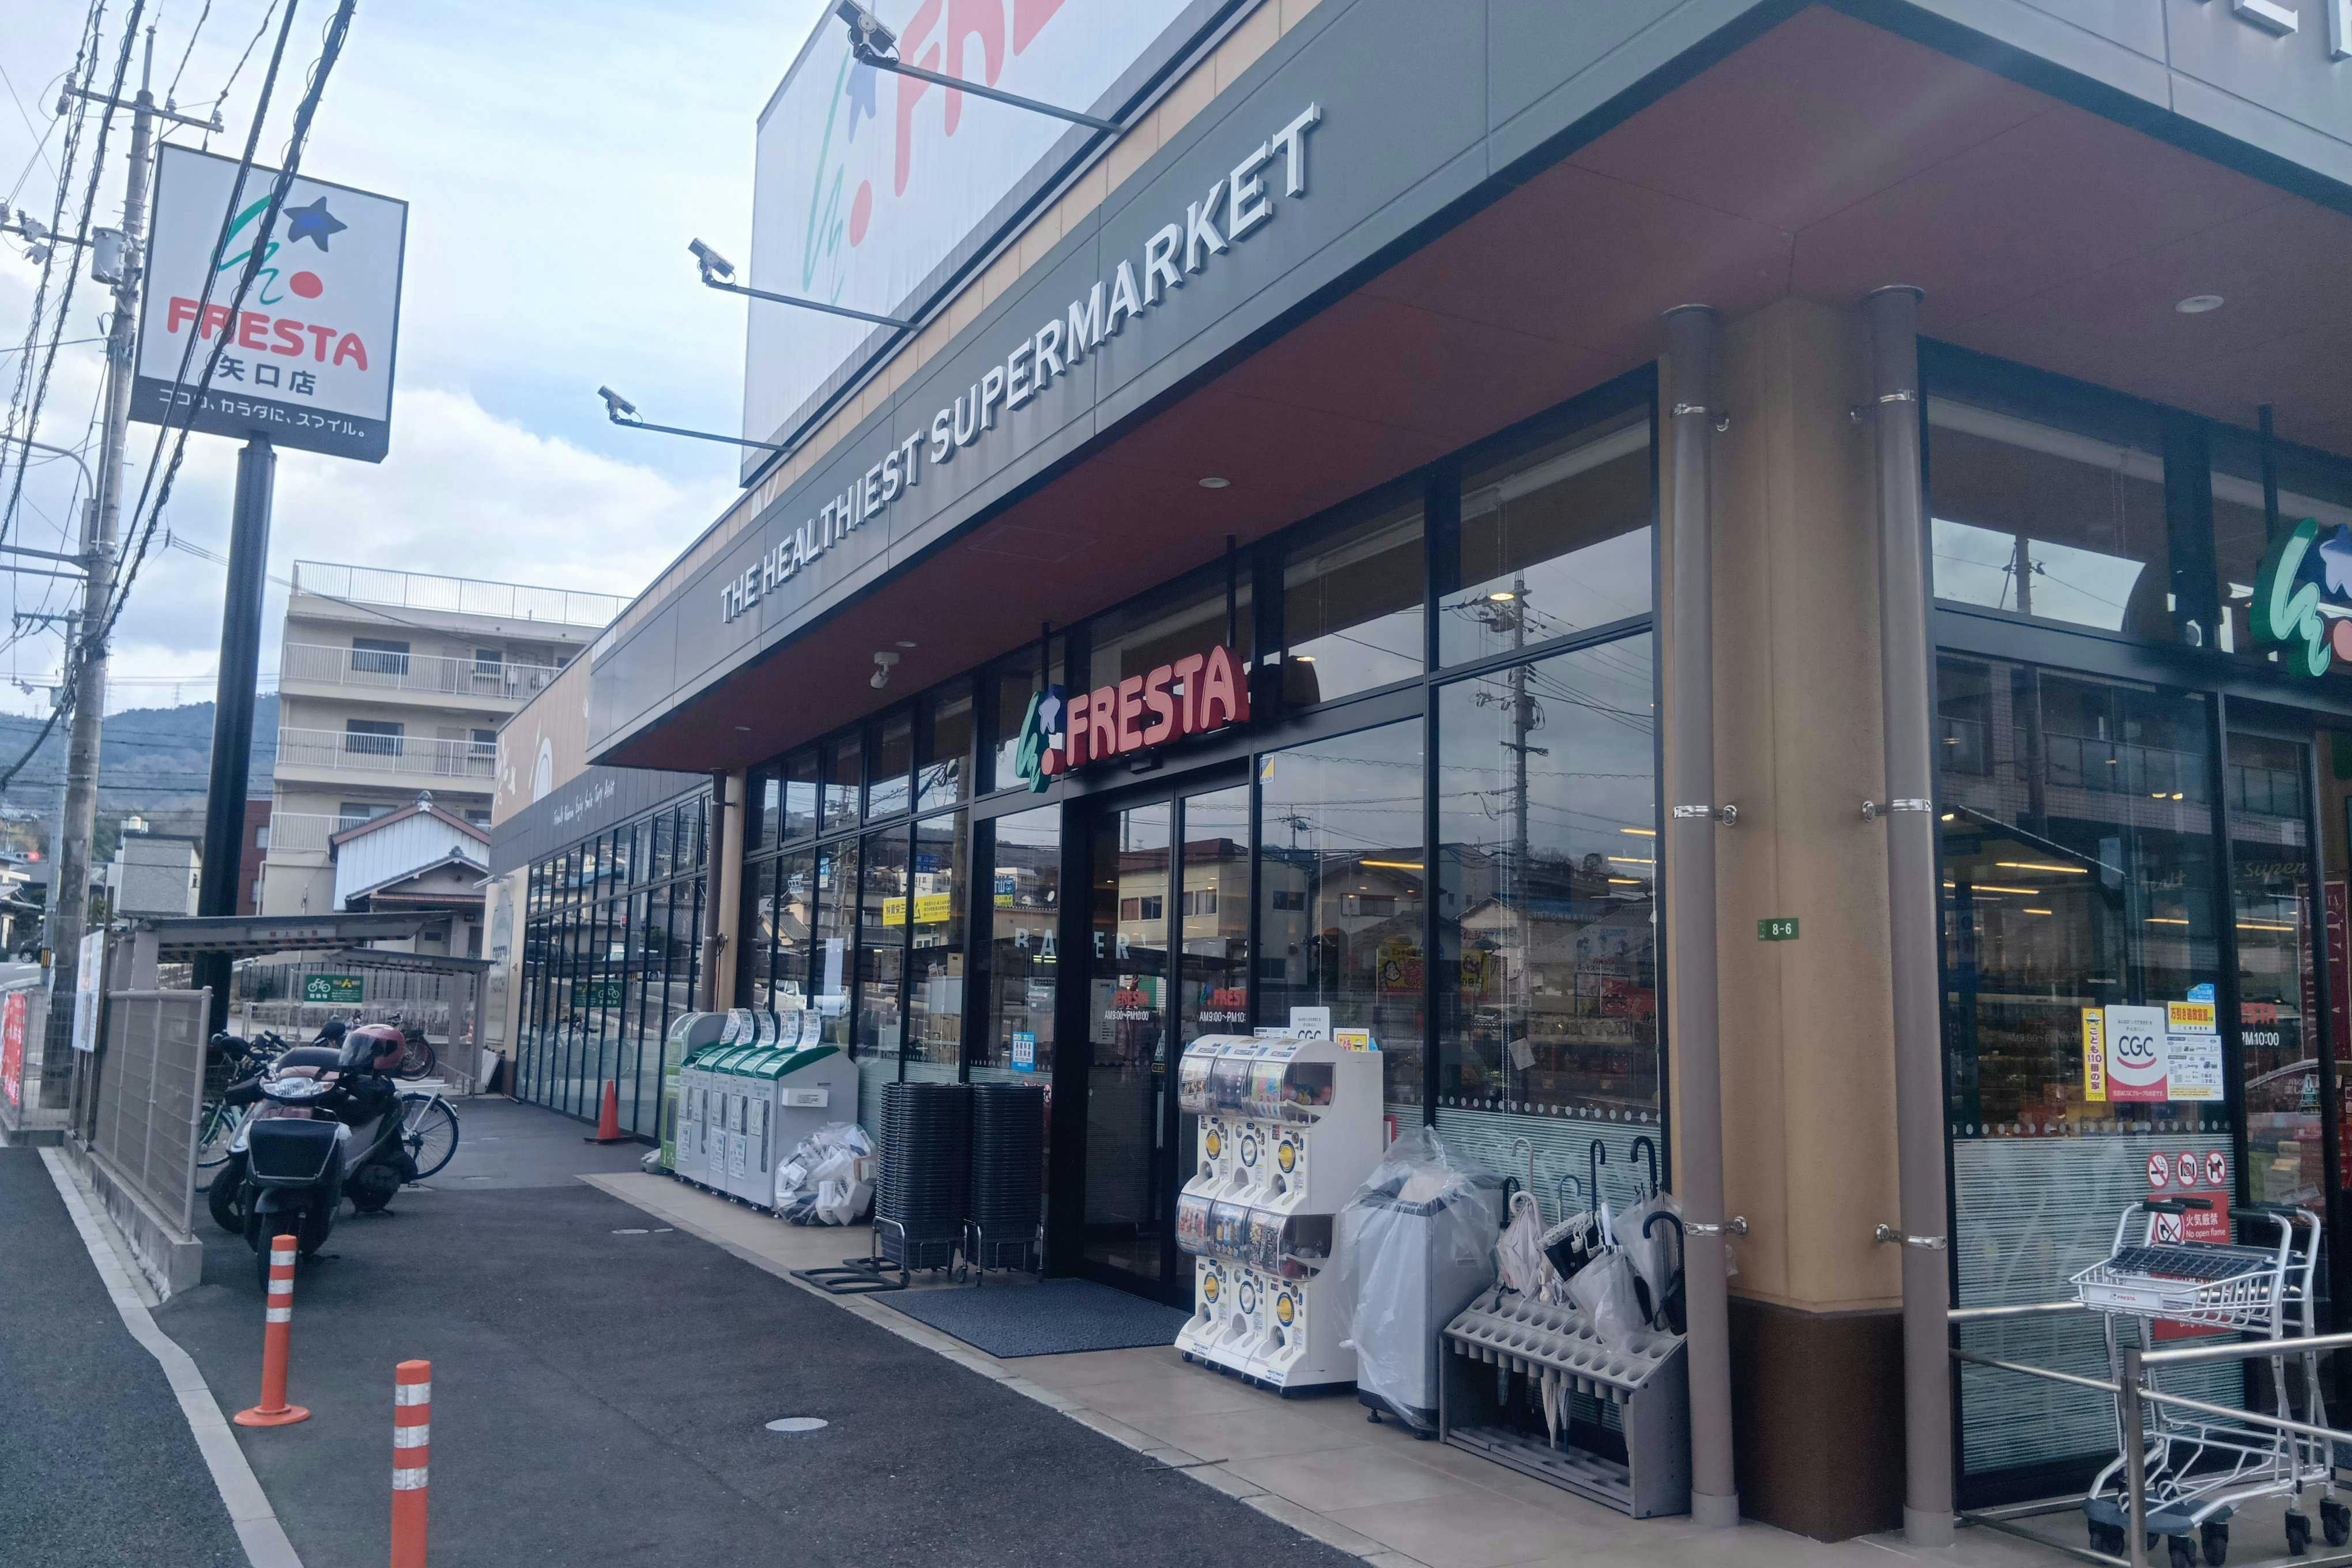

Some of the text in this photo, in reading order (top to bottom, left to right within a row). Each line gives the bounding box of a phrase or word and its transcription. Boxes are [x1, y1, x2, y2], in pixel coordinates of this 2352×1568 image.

[167, 296, 368, 371] FRESTA
[720, 101, 1322, 624] THE HEALTHIEST SUPERMARKET
[218, 355, 316, 396] 矢口店
[1066, 644, 1244, 767] FRESTA
[1772, 922, 1792, 935] 8-6
[1213, 989, 1247, 1006] FREST
[1199, 1011, 1246, 1023] AM9:00~PM10:
[2119, 1035, 2154, 1057] CGC
[2087, 1027, 2102, 1090] こども110番の家
[2186, 1213, 2219, 1227] 火気厳禁
[2186, 1228, 2226, 1239] No open flame
